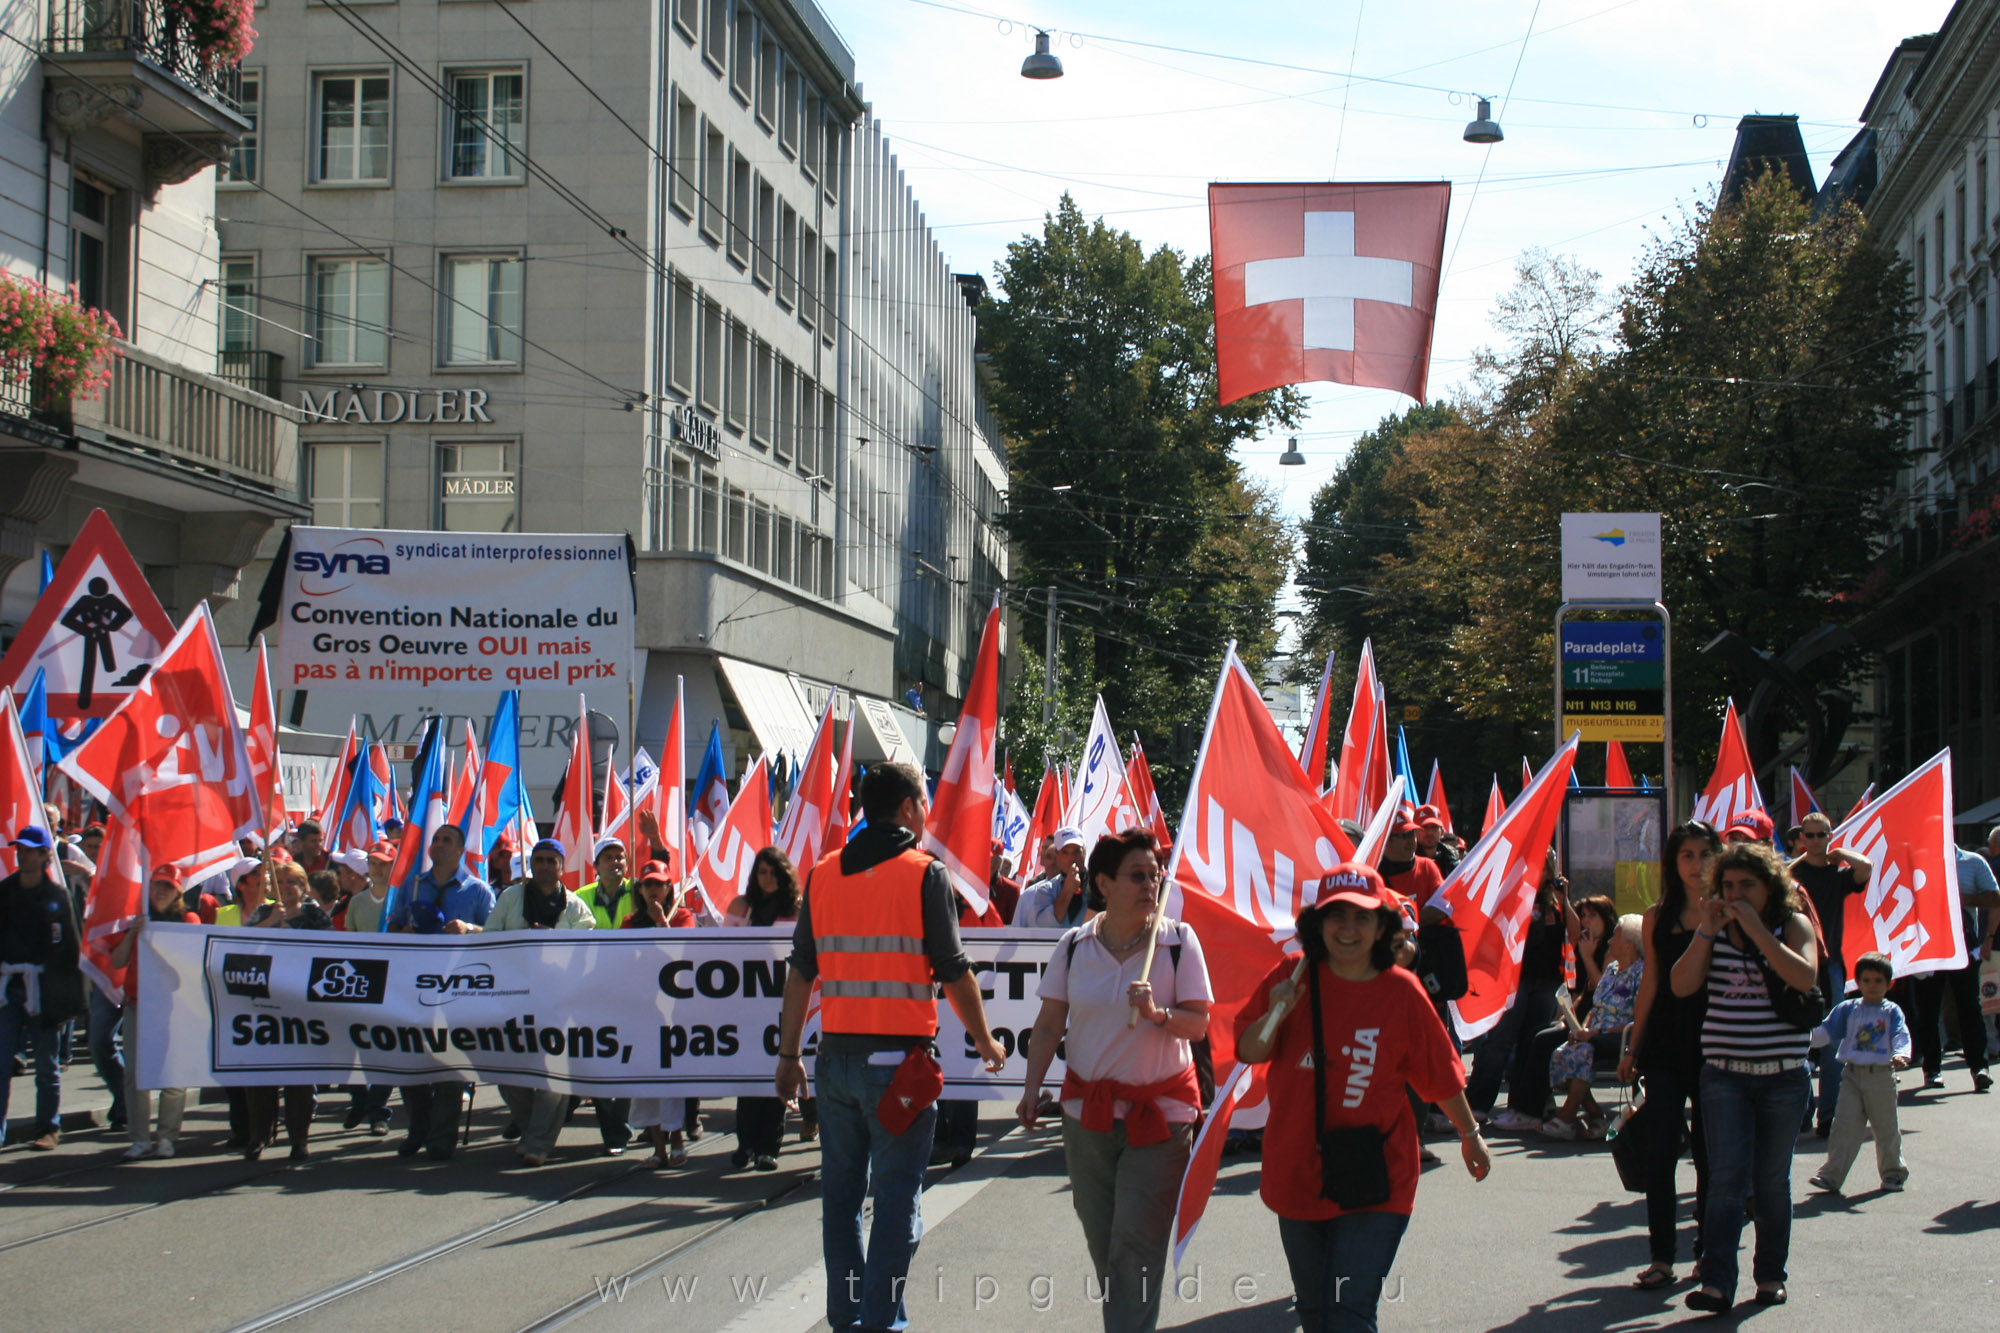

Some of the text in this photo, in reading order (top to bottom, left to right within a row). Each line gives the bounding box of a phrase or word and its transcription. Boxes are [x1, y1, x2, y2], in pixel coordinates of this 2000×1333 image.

[445, 478, 515, 494] MÄDLER
[395, 543, 622, 563] syndicat interprofessionnel
[293, 551, 390, 579] syna
[291, 602, 618, 628] Convention Nationale du
[313, 633, 592, 656] Gros Oeuvre OUI mais
[1564, 641, 1646, 656] Paradeplatz
[293, 658, 616, 687] pas à n'importe quel prix
[1572, 667, 1589, 684] 11
[1565, 700, 1637, 711] N11 N13 N16
[1649, 718, 1660, 727] 21
[322, 962, 369, 998] Sit
[416, 974, 495, 993] syna
[232, 1013, 330, 1046] sans
[349, 1015, 633, 1064] conventions,
[660, 1023, 740, 1069] pas
